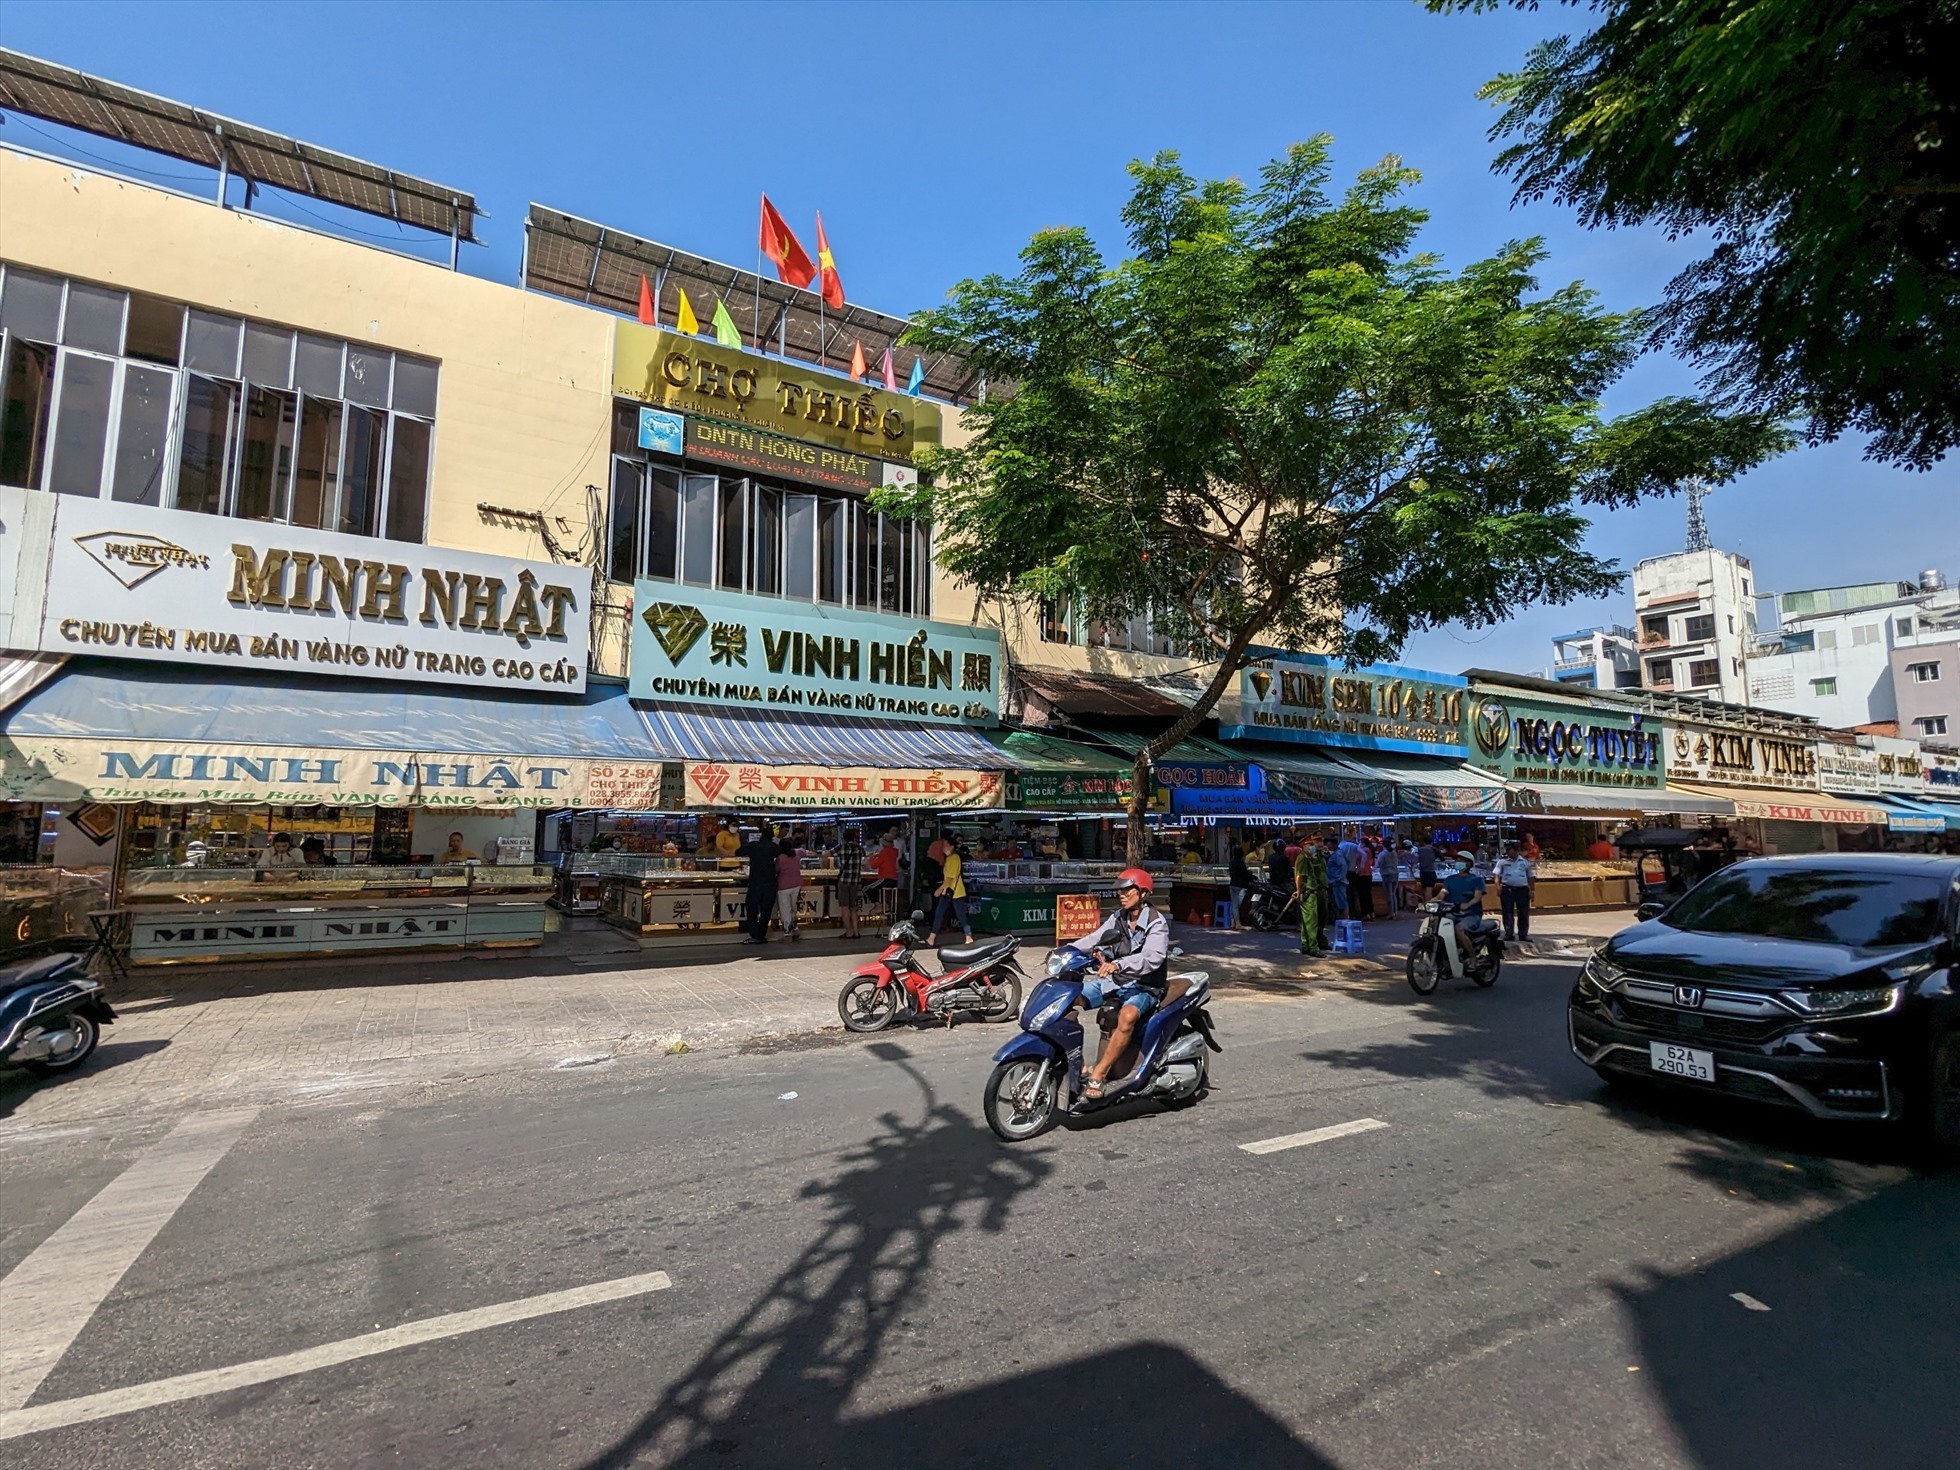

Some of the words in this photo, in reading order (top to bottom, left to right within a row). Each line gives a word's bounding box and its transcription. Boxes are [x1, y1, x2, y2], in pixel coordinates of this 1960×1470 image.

[662, 352, 760, 412] CHỢ
[776, 386, 905, 441] THIẾC
[697, 425, 754, 451] DNTN
[226, 543, 409, 620] MINH
[419, 568, 576, 643] NHẬT
[60, 620, 176, 650] CHUYÊN
[184, 629, 242, 656] MUA
[250, 632, 299, 659] BÁN
[306, 636, 371, 666] VÀNG
[375, 644, 409, 670] NỮ
[414, 651, 487, 677] TRANG
[492, 658, 535, 681] CAO
[539, 656, 579, 684] CẤP
[760, 627, 860, 682] VINH
[868, 629, 953, 691] HIỂN
[652, 676, 721, 699] CHUYÊN
[723, 683, 763, 702] MUA
[767, 684, 803, 706] BÁN
[806, 688, 853, 710] VÀNG
[855, 692, 876, 711] NỮ
[878, 697, 928, 716] TRANG
[931, 703, 960, 718] CAO
[1330, 676, 1373, 714] SEN
[1254, 711, 1282, 727] MUA
[1284, 711, 1307, 729] BÁN
[1512, 717, 1583, 764] NGỌC
[1584, 714, 1660, 765] TUYẾT
[1709, 731, 1754, 771] KIM
[1756, 738, 1808, 776] VINH
[98, 751, 343, 784] MINH
[371, 758, 570, 795] NHẬT
[591, 764, 614, 778] SỐ
[619, 768, 656, 779] 2-8A
[738, 766, 763, 792] 榮
[766, 775, 869, 793] VINH
[880, 771, 971, 794] HIỂN
[1153, 766, 1198, 788] GỌC
[1201, 765, 1247, 786] HOÀI
[590, 779, 617, 789] CHỢ
[1026, 788, 1040, 796] CAO
[1042, 786, 1056, 796] CẤP
[1081, 778, 1106, 794] KIM
[1108, 775, 1133, 796] LỘC
[82, 786, 187, 800] Chuyên
[198, 788, 262, 801] Mua
[331, 789, 398, 804] VÀNG
[496, 794, 559, 807] VÀNG
[561, 797, 582, 807] 18
[733, 794, 786, 805] CHUYÊN
[790, 796, 817, 805] MUA
[821, 795, 846, 806] BÁN
[849, 795, 880, 806] VÀNG
[883, 796, 899, 806] NỮ
[902, 797, 938, 806] TRANG
[941, 797, 962, 806] CAO
[1767, 804, 1812, 820] KIM
[1818, 808, 1866, 822] VINH
[1022, 909, 1048, 922] KIM
[153, 925, 296, 943] MINH
[323, 917, 458, 937] NHẬT
[1667, 1046, 1695, 1064] 62A
[1657, 1058, 1707, 1079] 290.53
